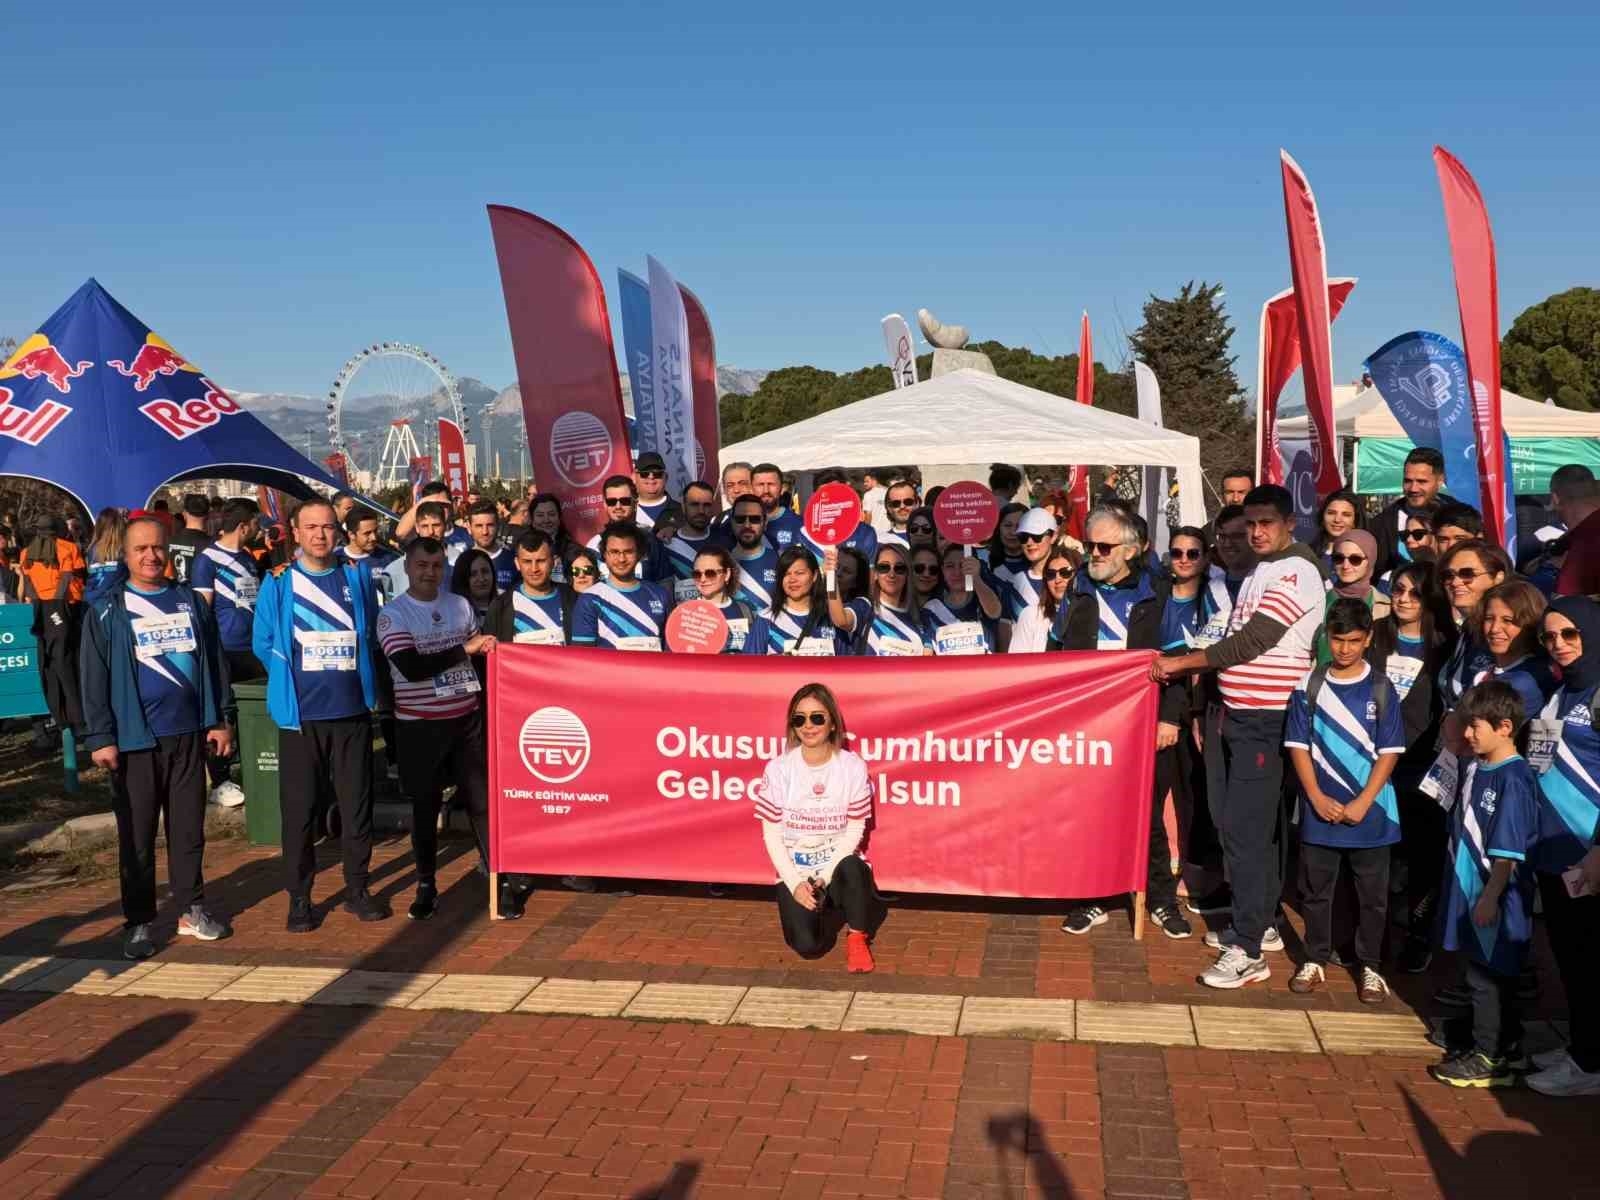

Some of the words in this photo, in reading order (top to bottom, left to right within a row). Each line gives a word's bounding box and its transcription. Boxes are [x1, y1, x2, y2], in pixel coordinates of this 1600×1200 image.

[138, 377, 246, 440] Red
[527, 747, 583, 766] TEV
[845, 731, 1113, 769] umhuriyetin
[503, 788, 534, 799] TÜRK
[535, 789, 575, 801] EĞİTİM
[656, 769, 764, 801] Gelec
[878, 773, 961, 807] lsun
